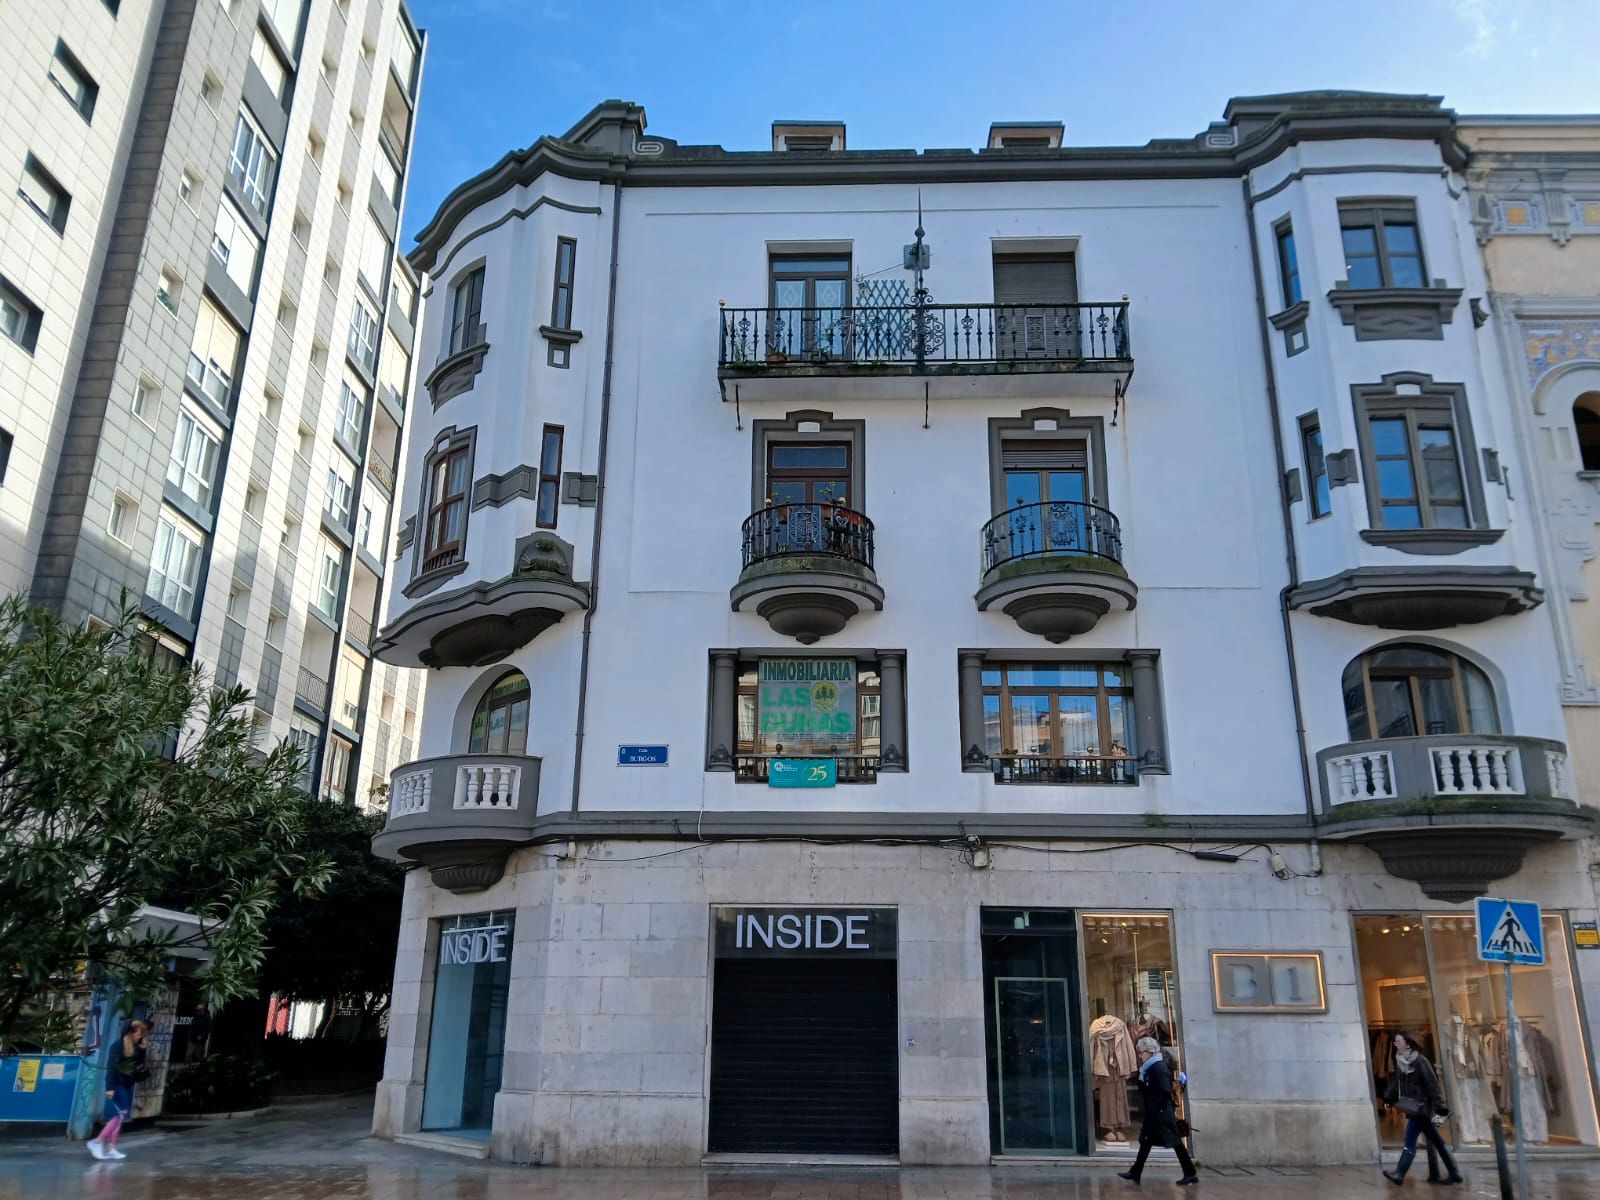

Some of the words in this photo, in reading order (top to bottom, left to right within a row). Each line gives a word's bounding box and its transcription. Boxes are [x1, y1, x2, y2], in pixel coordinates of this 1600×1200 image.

[763, 661, 852, 681] INMOBILIARIA
[761, 687, 811, 707] LAS
[629, 755, 657, 763] BURGOS
[807, 764, 827, 783] 25
[735, 914, 870, 949] INSIDE
[440, 930, 508, 965] INSIDE
